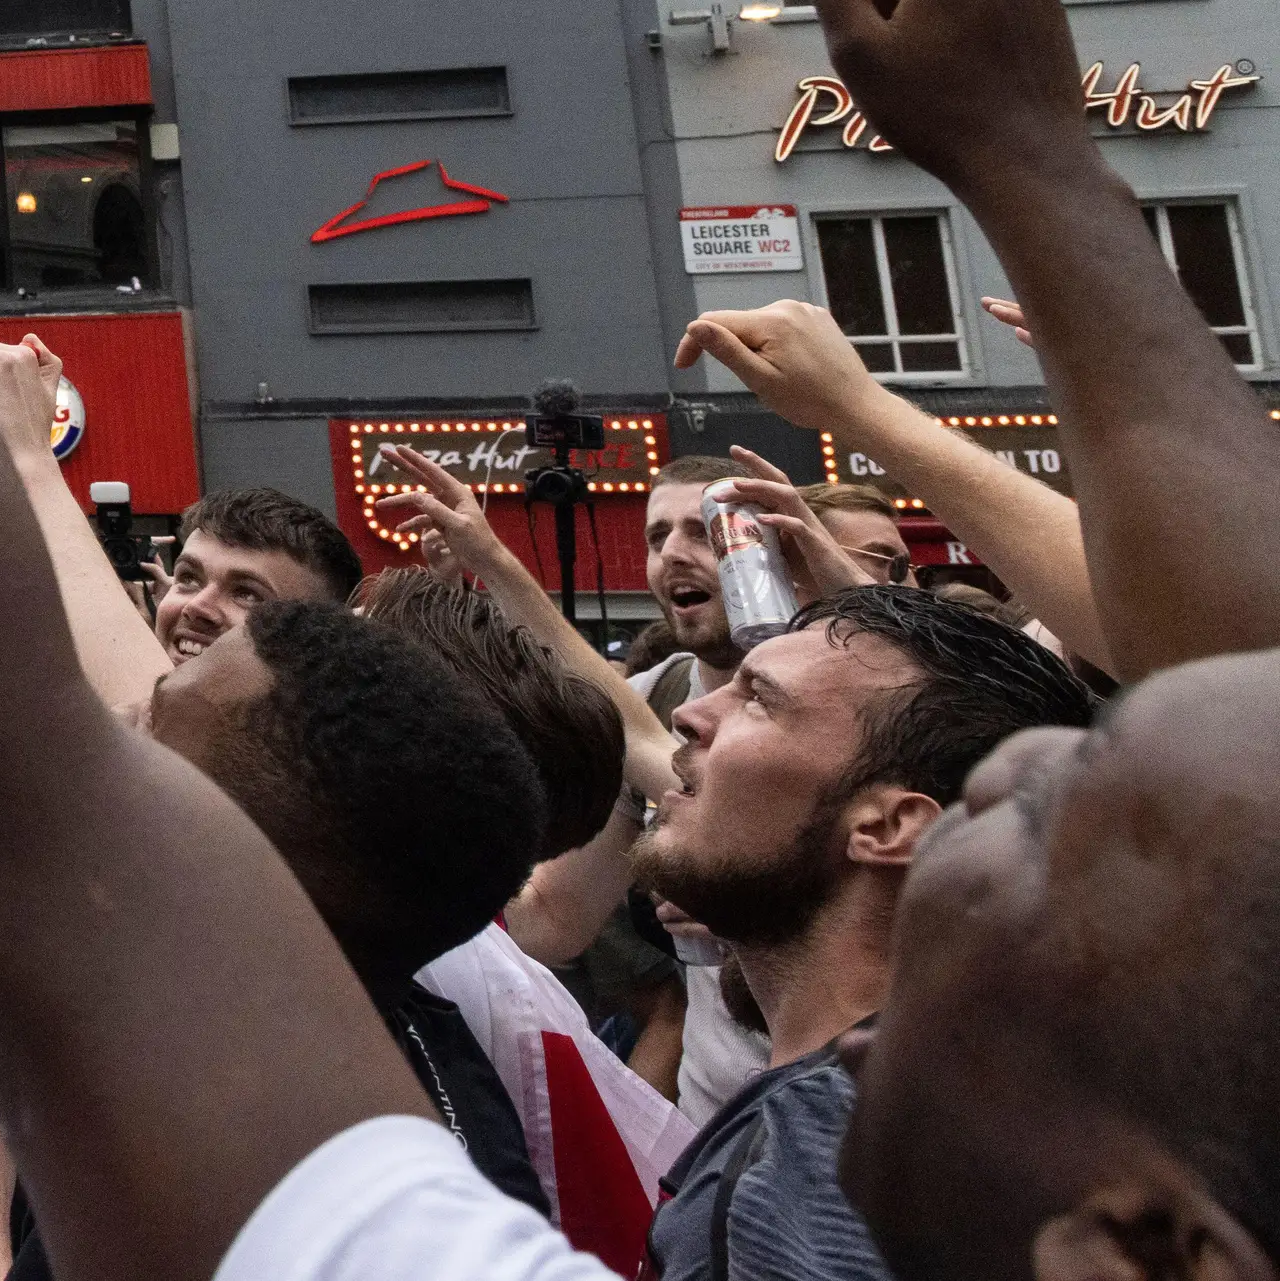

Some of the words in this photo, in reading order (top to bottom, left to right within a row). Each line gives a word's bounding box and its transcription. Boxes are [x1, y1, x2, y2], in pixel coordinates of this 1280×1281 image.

[691, 223, 770, 239] LEICESTER
[693, 240, 753, 255] SQUARE
[758, 239, 791, 253] WC2
[466, 440, 539, 471] Hut
